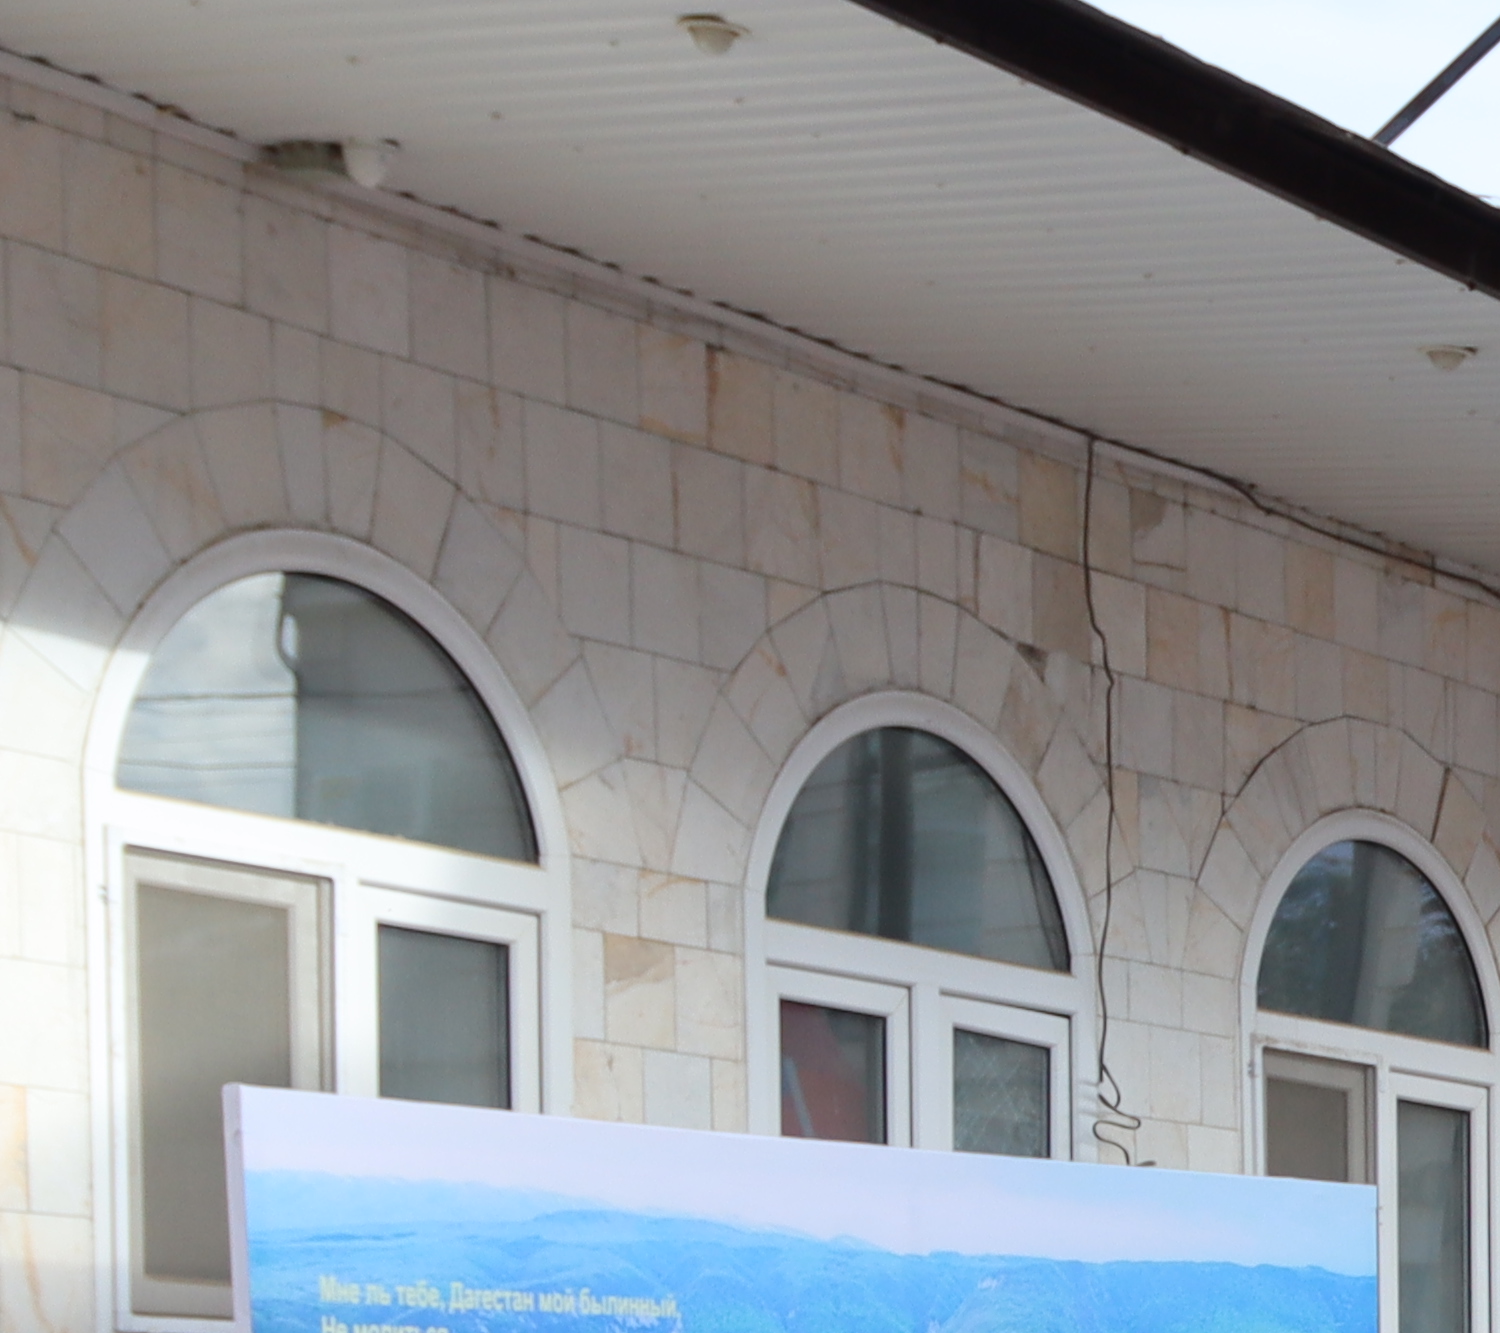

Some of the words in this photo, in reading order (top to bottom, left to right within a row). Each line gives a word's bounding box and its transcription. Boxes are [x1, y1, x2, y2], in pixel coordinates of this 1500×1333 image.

[320, 1276, 361, 1303] Мне
[365, 1282, 390, 1305] ль
[394, 1279, 444, 1312] тебе,
[450, 1282, 534, 1314] Дагестан
[539, 1288, 574, 1314] мой
[579, 1286, 681, 1319] былинный,
